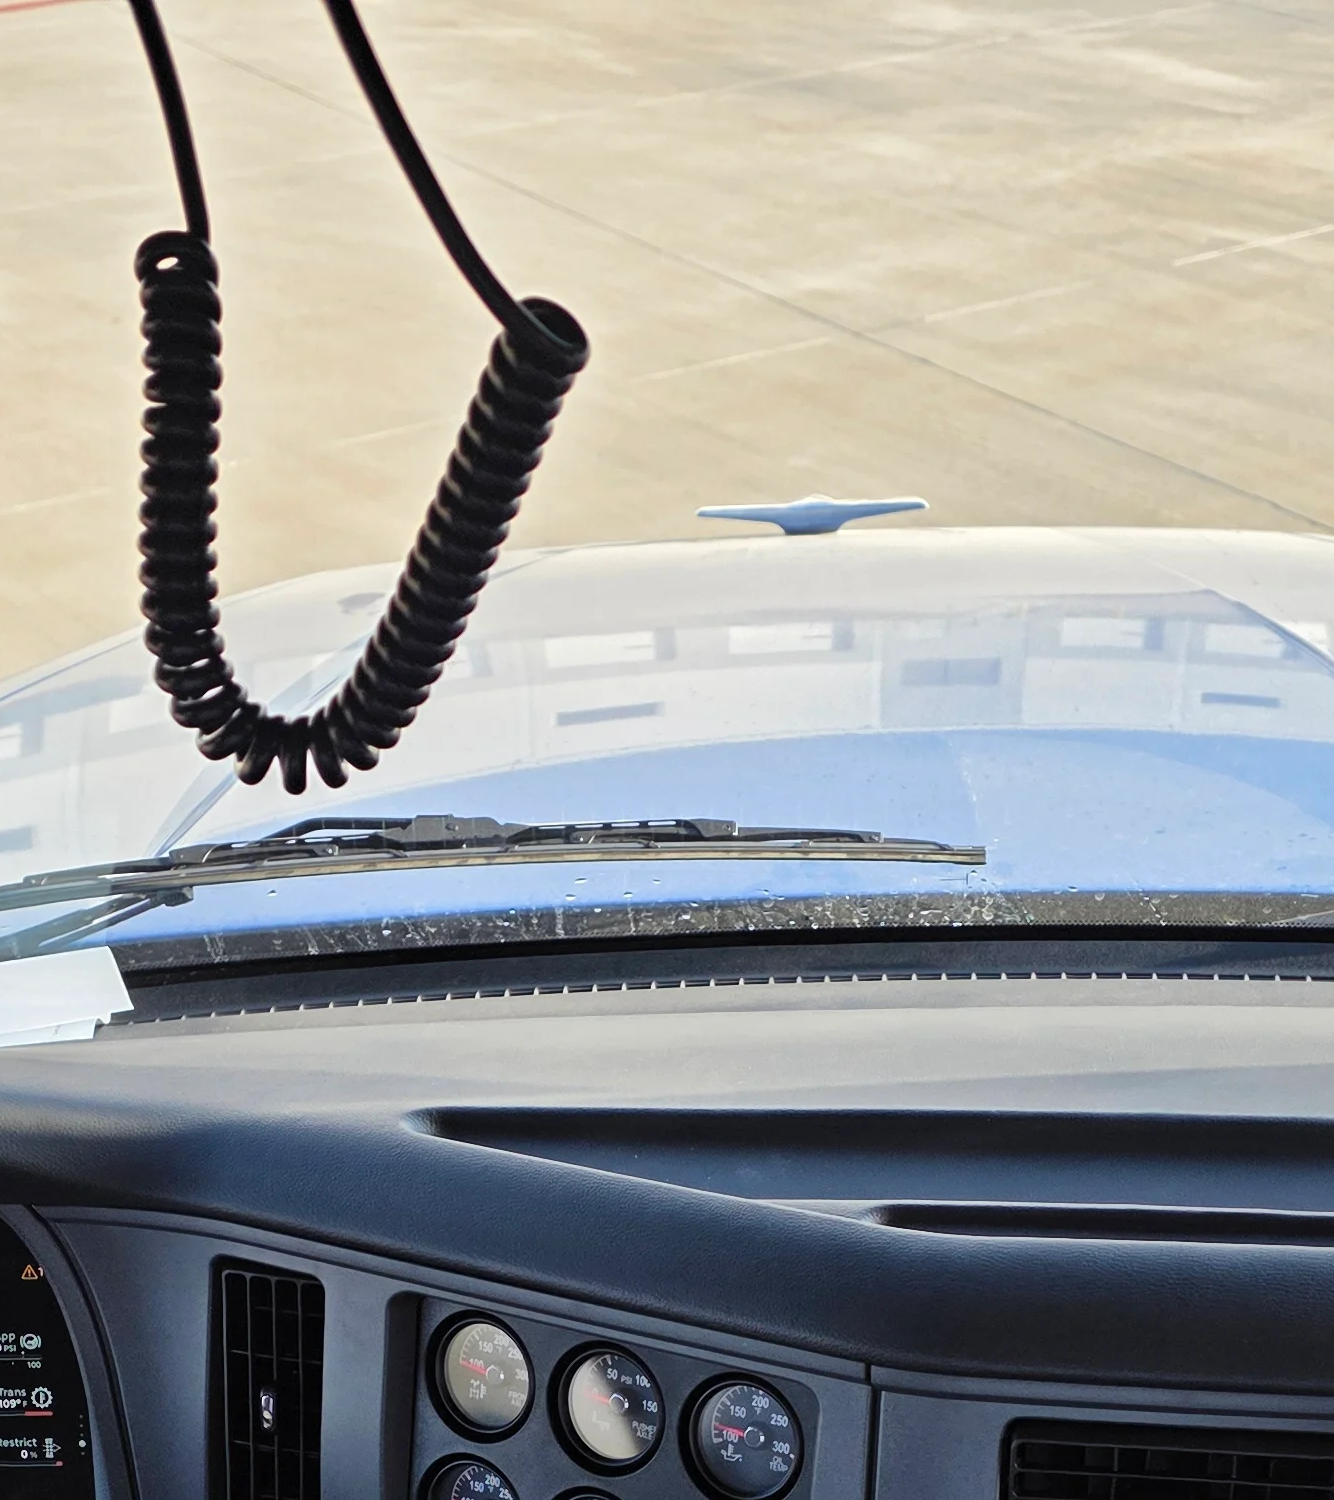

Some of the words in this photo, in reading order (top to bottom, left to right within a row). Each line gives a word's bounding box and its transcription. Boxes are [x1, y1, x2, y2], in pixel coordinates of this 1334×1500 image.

[3, 1344, 17, 1352] PSI
[478, 1341, 493, 1354] 150
[26, 1361, 42, 1370] 100
[607, 1367, 618, 1380] 50
[621, 1374, 632, 1385] PSI
[642, 1399, 658, 1413] 150
[751, 1395, 769, 1409] 200
[729, 1404, 747, 1419] 150
[770, 1413, 789, 1427] 250
[722, 1429, 739, 1443] 100
[772, 1440, 790, 1455] 300
[21, 1450, 28, 1459] 0
[769, 1461, 788, 1473] TEMP
[469, 1480, 484, 1493] 150
[484, 1473, 501, 1488] 200
